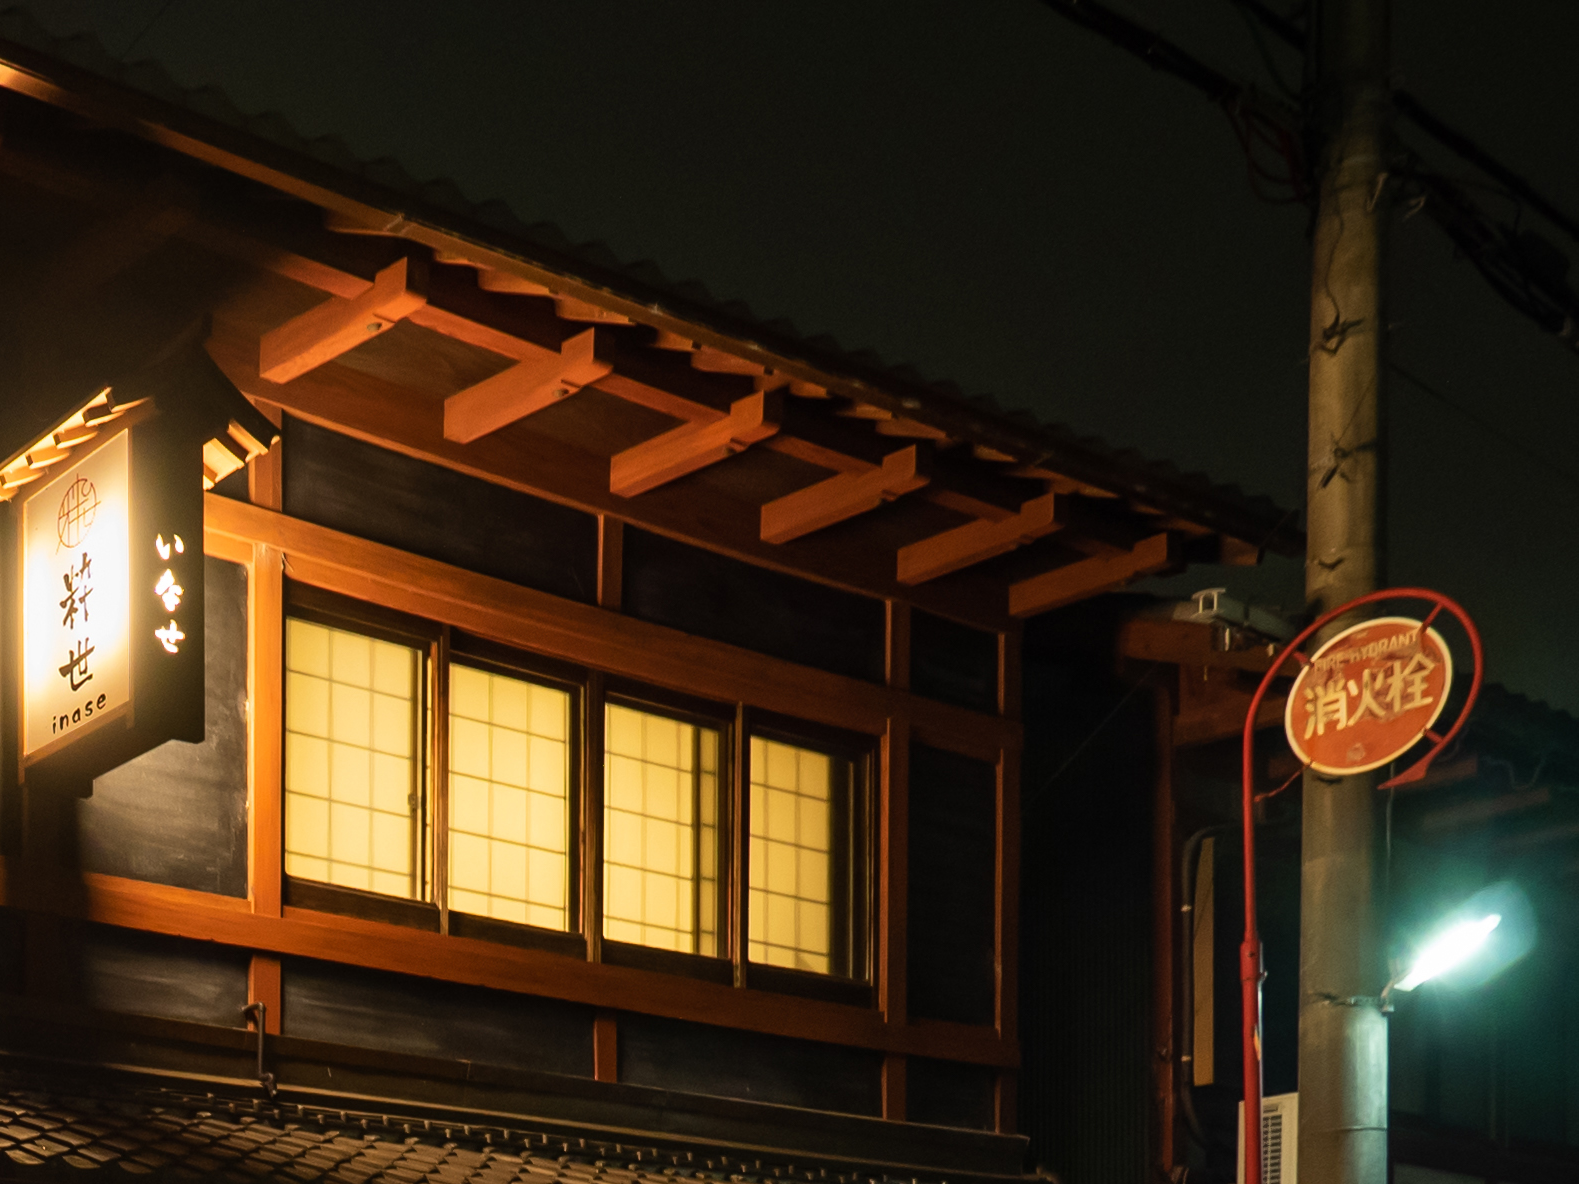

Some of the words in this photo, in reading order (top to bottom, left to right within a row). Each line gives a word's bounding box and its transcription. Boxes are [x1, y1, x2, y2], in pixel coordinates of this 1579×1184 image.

[153, 533, 186, 654] いなせ
[1350, 629, 1419, 663] HYDRANT
[52, 693, 107, 734] inase
[1303, 652, 1436, 740] 消火栓
